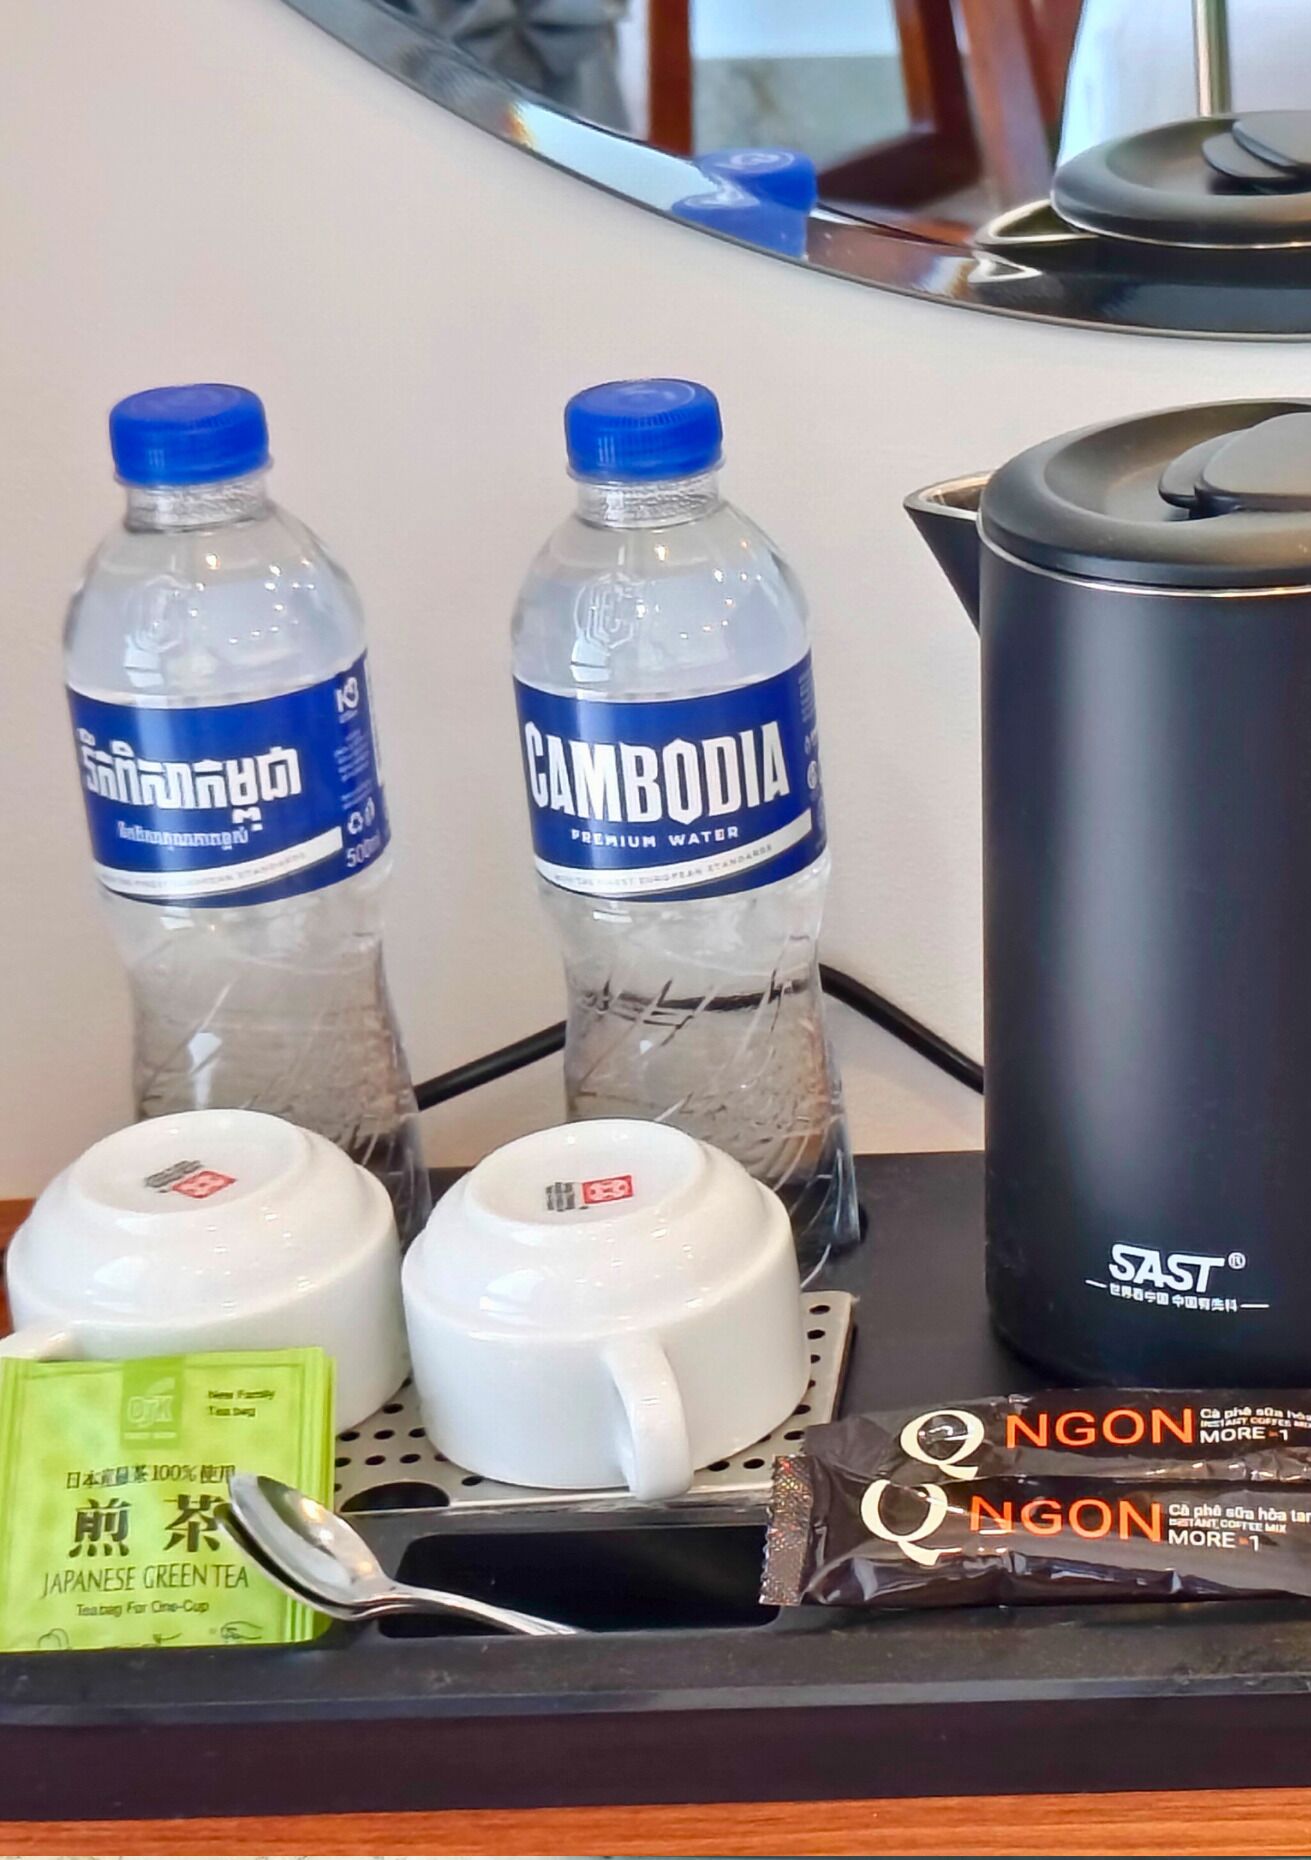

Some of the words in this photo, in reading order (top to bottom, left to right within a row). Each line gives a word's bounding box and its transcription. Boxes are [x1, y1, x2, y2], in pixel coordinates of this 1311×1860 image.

[525, 720, 790, 825] CAMBODIA
[571, 828, 657, 848] PREMIUM
[669, 826, 739, 847] WATER
[208, 1390, 234, 1400] New
[237, 1388, 276, 1401] Family
[900, 1409, 986, 1481] Q
[1006, 1407, 1193, 1449] NGON
[1200, 1426, 1267, 1444] MORE
[861, 1478, 962, 1566] Q
[969, 1495, 1164, 1543] NGON
[1168, 1504, 1190, 1517] Cà
[1193, 1503, 1222, 1519] phê
[1258, 1506, 1288, 1522] hòa
[1169, 1518, 1219, 1529] INSTANT
[1220, 1519, 1263, 1532] COFFEE
[1265, 1522, 1287, 1534] MIX
[1168, 1529, 1236, 1549] MORE
[41, 1565, 137, 1599] JAPANESE
[143, 1562, 207, 1589] GREEN
[211, 1563, 250, 1589] TEA
[126, 1601, 149, 1614] For
[151, 1599, 210, 1615] One-Cup
